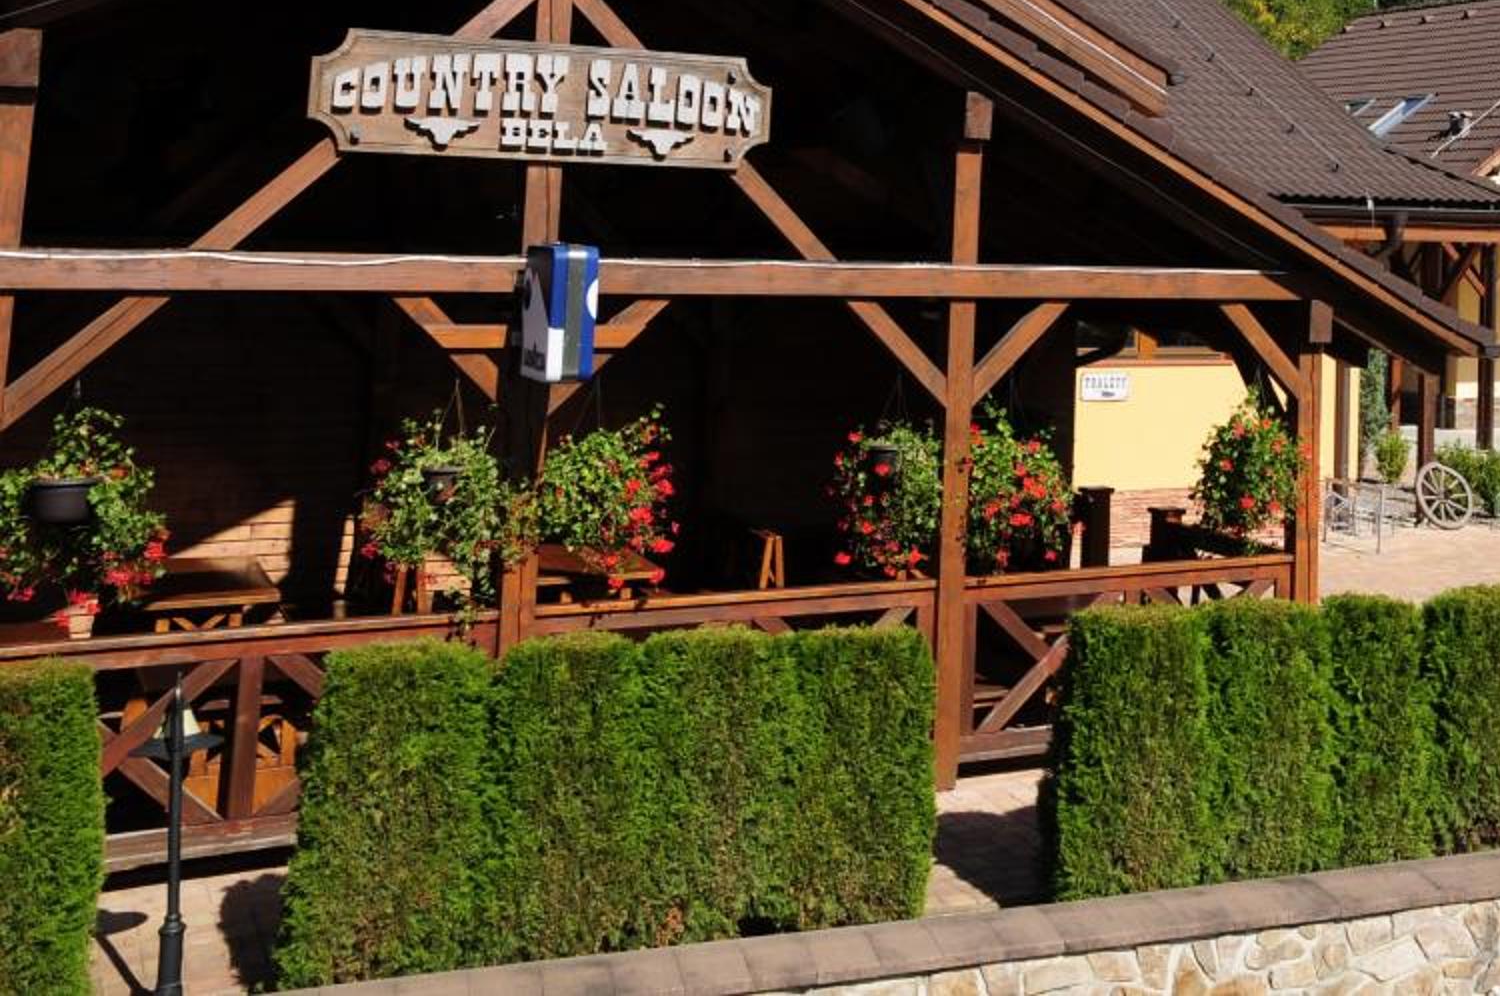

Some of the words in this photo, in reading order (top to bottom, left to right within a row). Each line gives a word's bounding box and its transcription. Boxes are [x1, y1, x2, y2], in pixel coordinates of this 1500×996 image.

[331, 53, 570, 118] COUNTRY
[587, 59, 760, 137] SALOON
[499, 118, 607, 155] BELA
